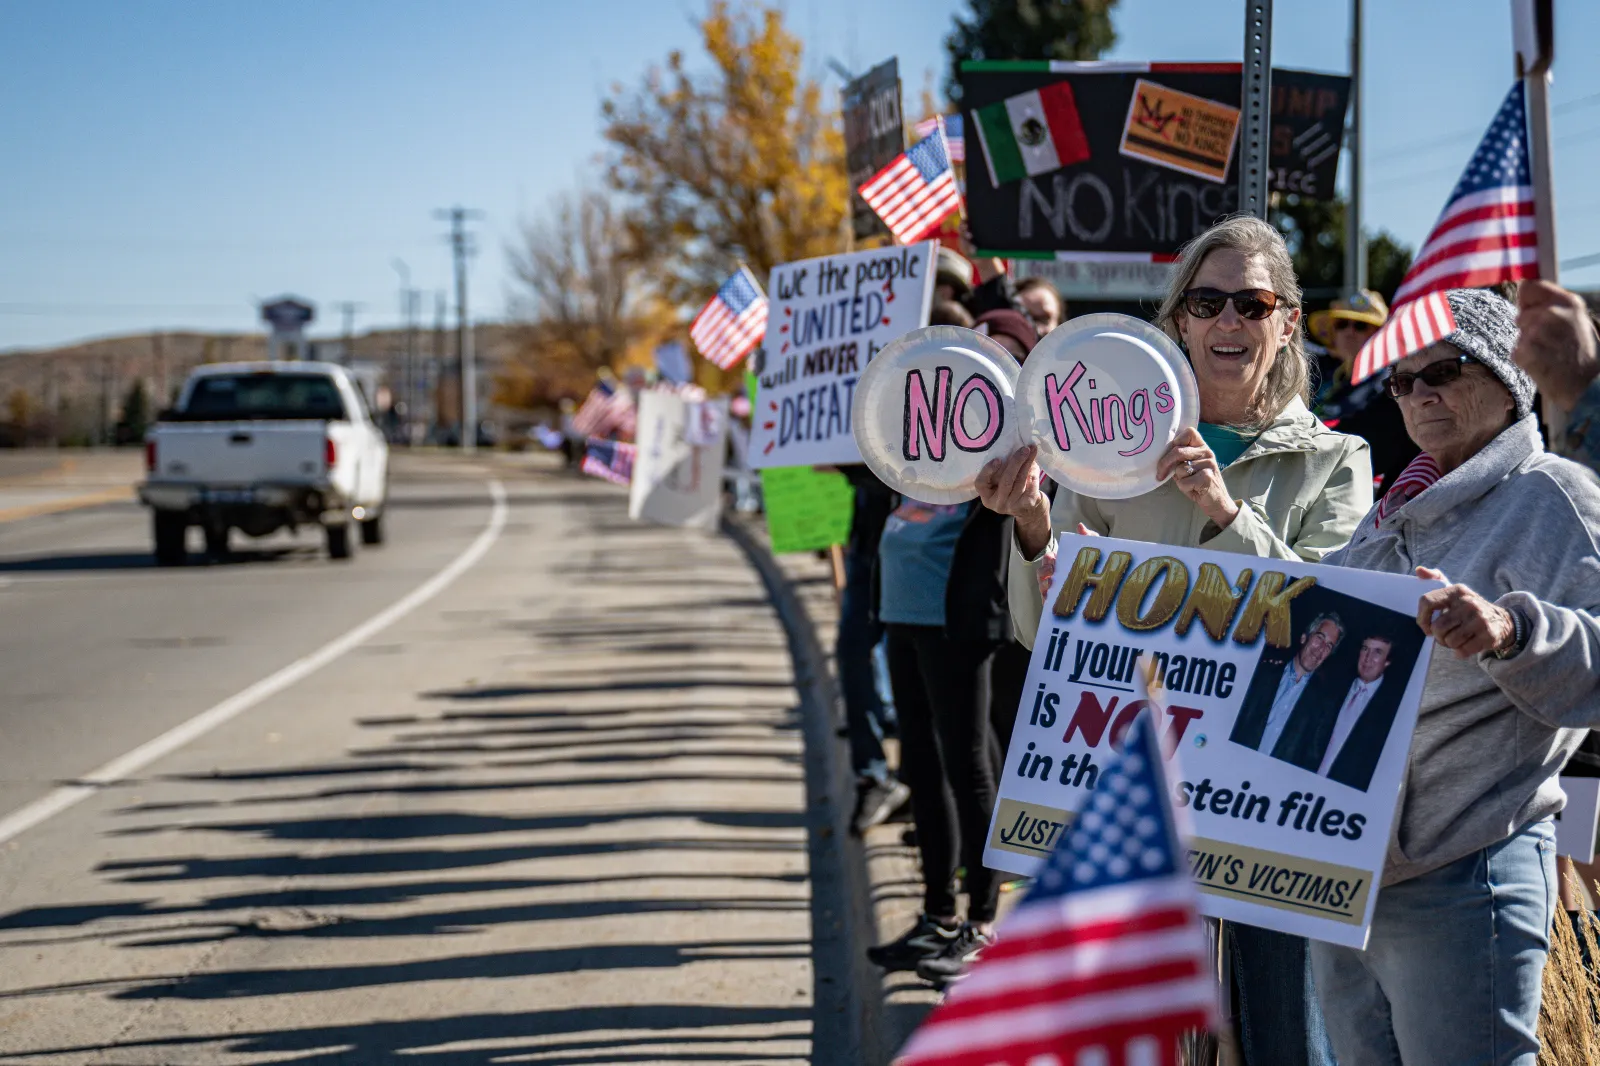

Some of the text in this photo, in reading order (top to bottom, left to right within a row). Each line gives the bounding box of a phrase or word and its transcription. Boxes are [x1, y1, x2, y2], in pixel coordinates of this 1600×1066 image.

[1018, 172, 1114, 243] NO
[818, 259, 849, 297] the
[854, 248, 920, 299] people
[792, 291, 884, 348] UNITED
[761, 355, 798, 390] will
[802, 340, 859, 378] NEVER
[778, 376, 860, 448] DEFEAT
[902, 366, 1004, 463] NO
[1044, 360, 1175, 458] Kings
[1052, 546, 1318, 649] HONK
[1043, 628, 1238, 700] if your name
[1029, 682, 1061, 729] is
[1017, 741, 1053, 782] in
[1059, 752, 1100, 791] th
[1276, 790, 1368, 842] files
[1247, 861, 1364, 909] VICTIMS!
